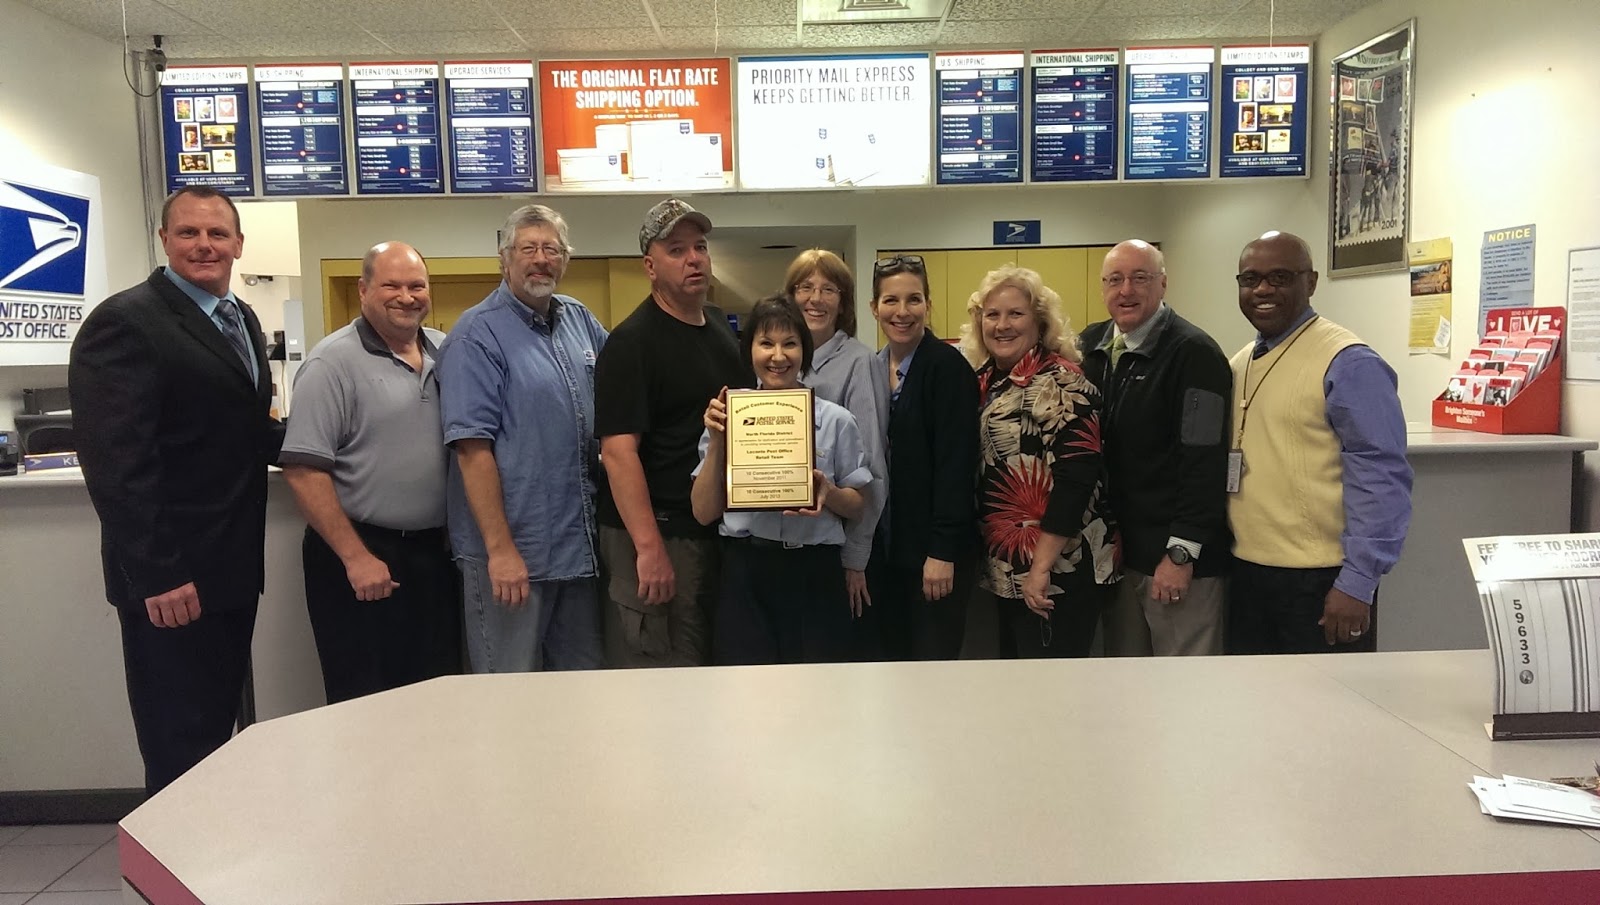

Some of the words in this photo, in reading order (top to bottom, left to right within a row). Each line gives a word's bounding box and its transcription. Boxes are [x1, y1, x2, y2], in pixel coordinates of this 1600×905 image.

[955, 58, 985, 66] SHIPPING
[1036, 55, 1083, 64] INTERNATIONAL
[1085, 54, 1115, 62] SHIPPING
[274, 69, 304, 78] SHPPNG
[354, 68, 402, 76] INTERNATIONAL
[404, 67, 434, 75] SHIPPING
[449, 67, 478, 75] UPGRADE
[481, 66, 511, 75] SERVICES
[752, 68, 812, 84] PRIORITY
[819, 68, 849, 83] MAIL
[856, 66, 915, 82] EXPRESS
[551, 70, 578, 88] THE
[581, 69, 646, 87] ORIGINAL
[650, 68, 681, 86] FLAT
[685, 68, 718, 86] RATE
[576, 90, 640, 108] SHIPPING
[644, 89, 699, 107] OPTION.
[754, 88, 794, 104] KEEPS
[800, 87, 855, 103] GETTING
[862, 86, 914, 102] BETTER.
[1488, 228, 1531, 242] NOTICE
[41, 304, 83, 320] STATES
[735, 405, 749, 414] Retail
[776, 401, 803, 413] Experience
[1477, 542, 1503, 554] FEE
[1544, 541, 1561, 551] TO
[1564, 539, 1600, 550] SHAR
[1513, 599, 1530, 664] 59633
